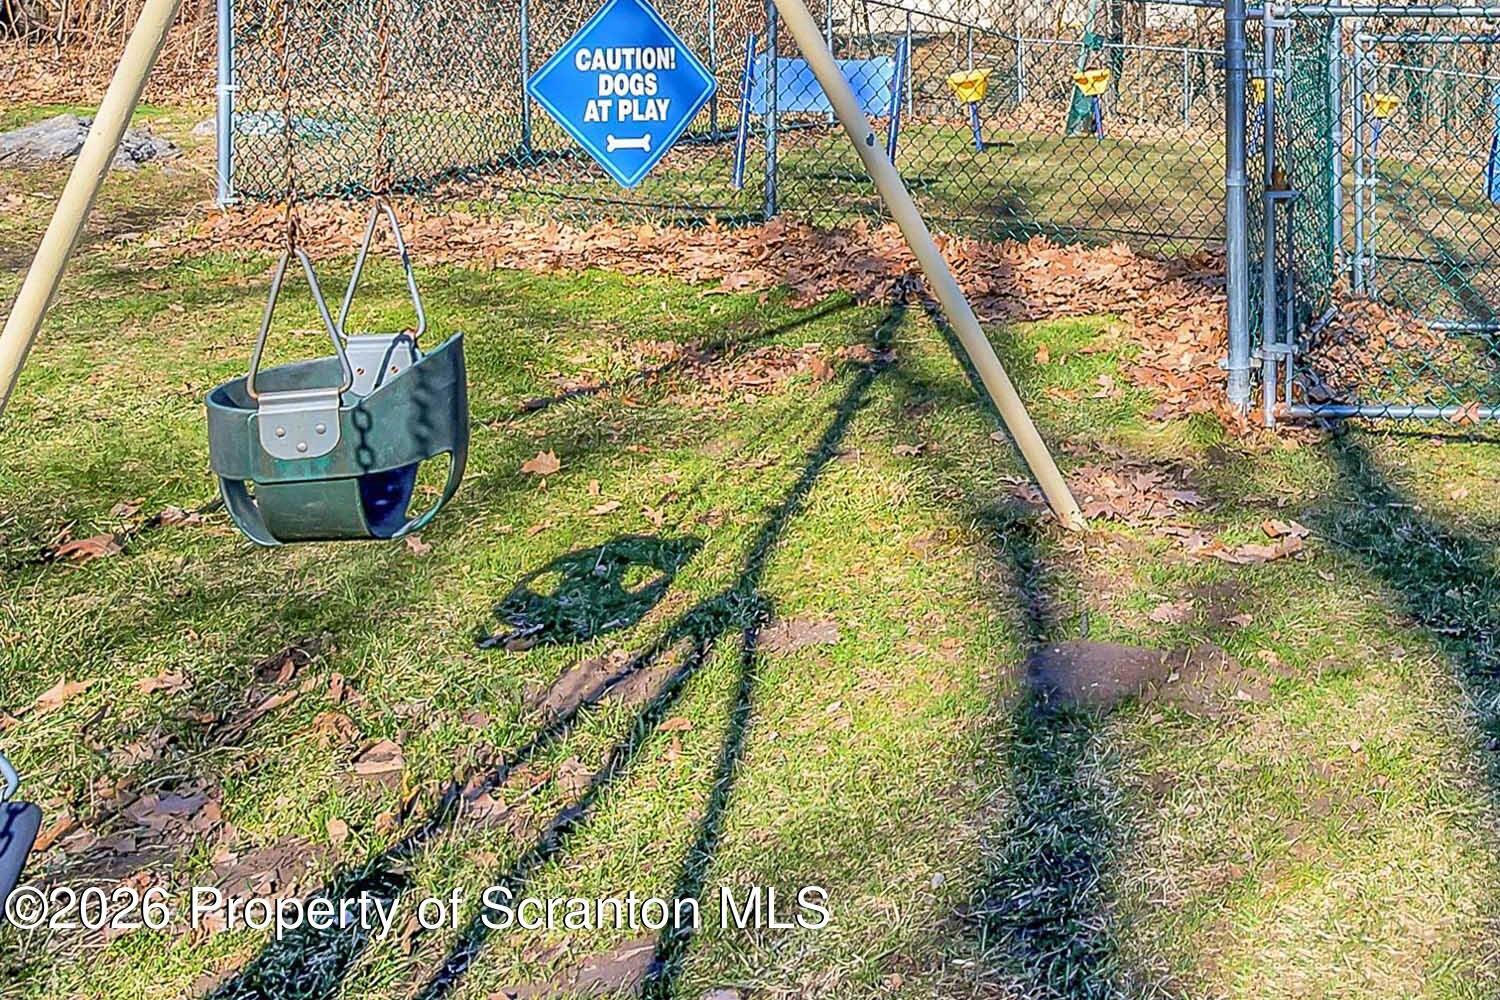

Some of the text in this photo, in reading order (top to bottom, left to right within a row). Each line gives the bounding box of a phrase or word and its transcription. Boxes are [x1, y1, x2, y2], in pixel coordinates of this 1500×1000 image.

[575, 47, 676, 71] CAUTION!
[598, 73, 658, 97] DOGS
[584, 99, 671, 122] AT PLAY
